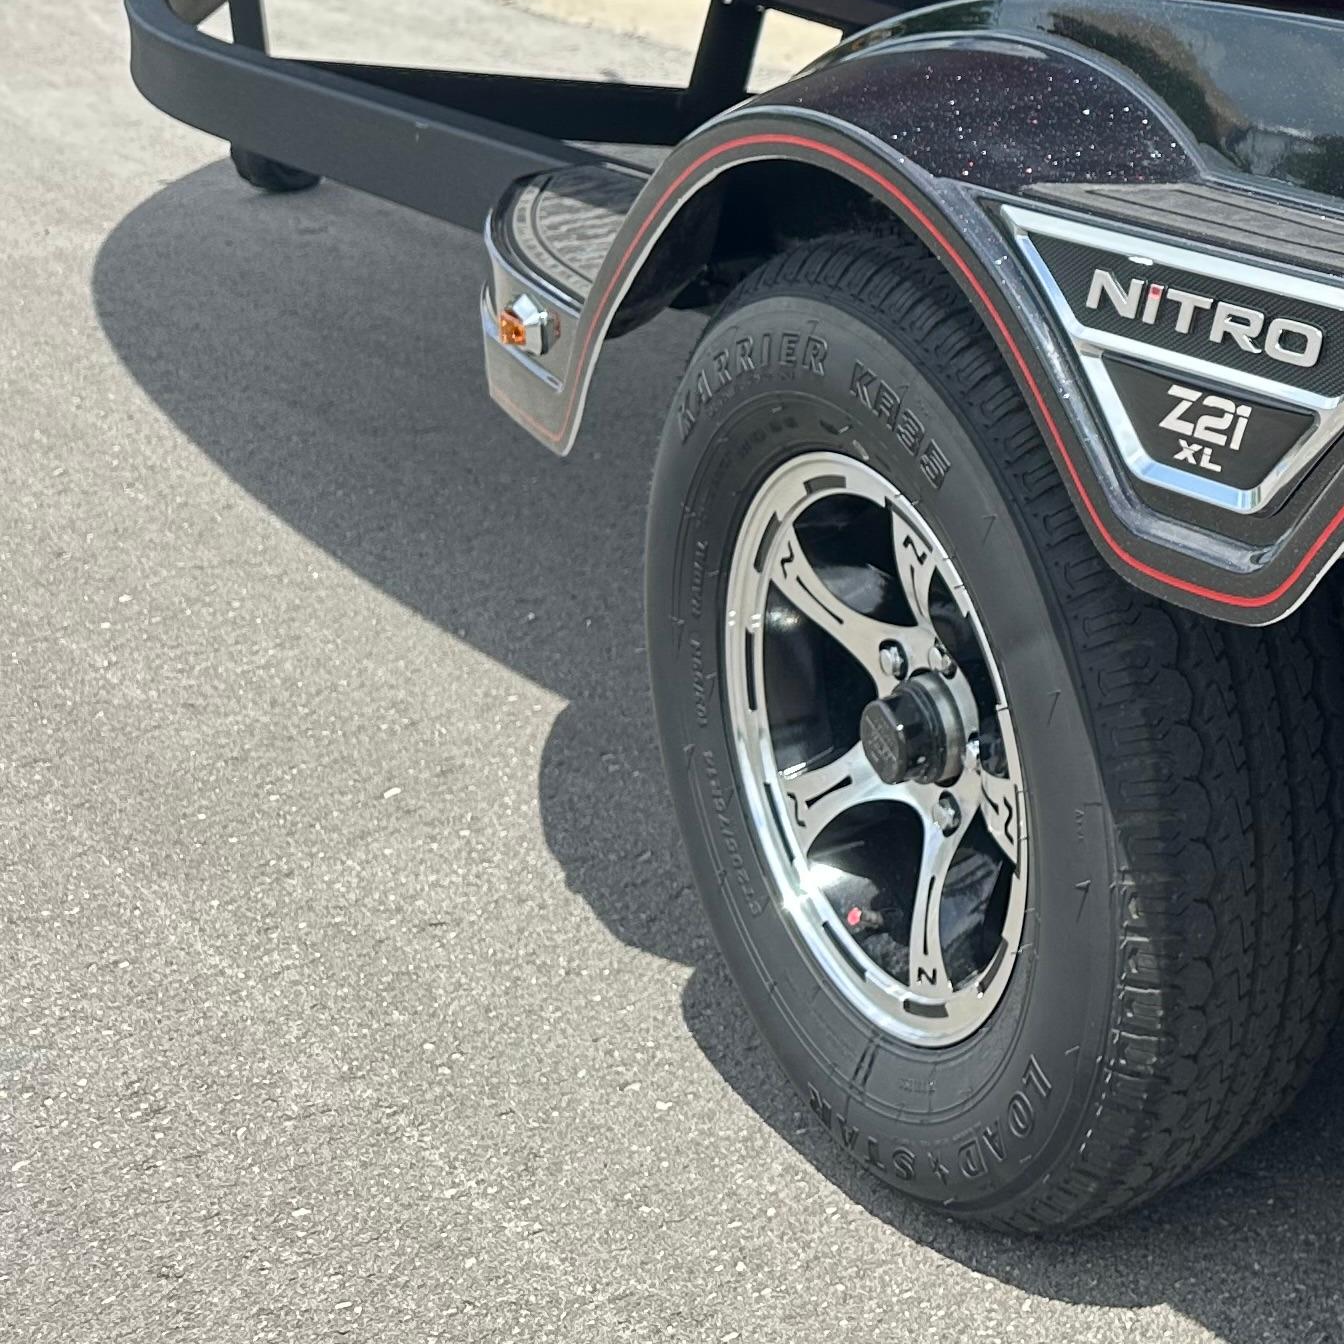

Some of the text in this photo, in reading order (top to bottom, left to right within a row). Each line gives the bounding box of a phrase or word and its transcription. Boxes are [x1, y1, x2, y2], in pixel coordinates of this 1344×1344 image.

[677, 331, 829, 445] KARRIER
[1157, 383, 1253, 452] Z21
[1172, 438, 1223, 473] XL
